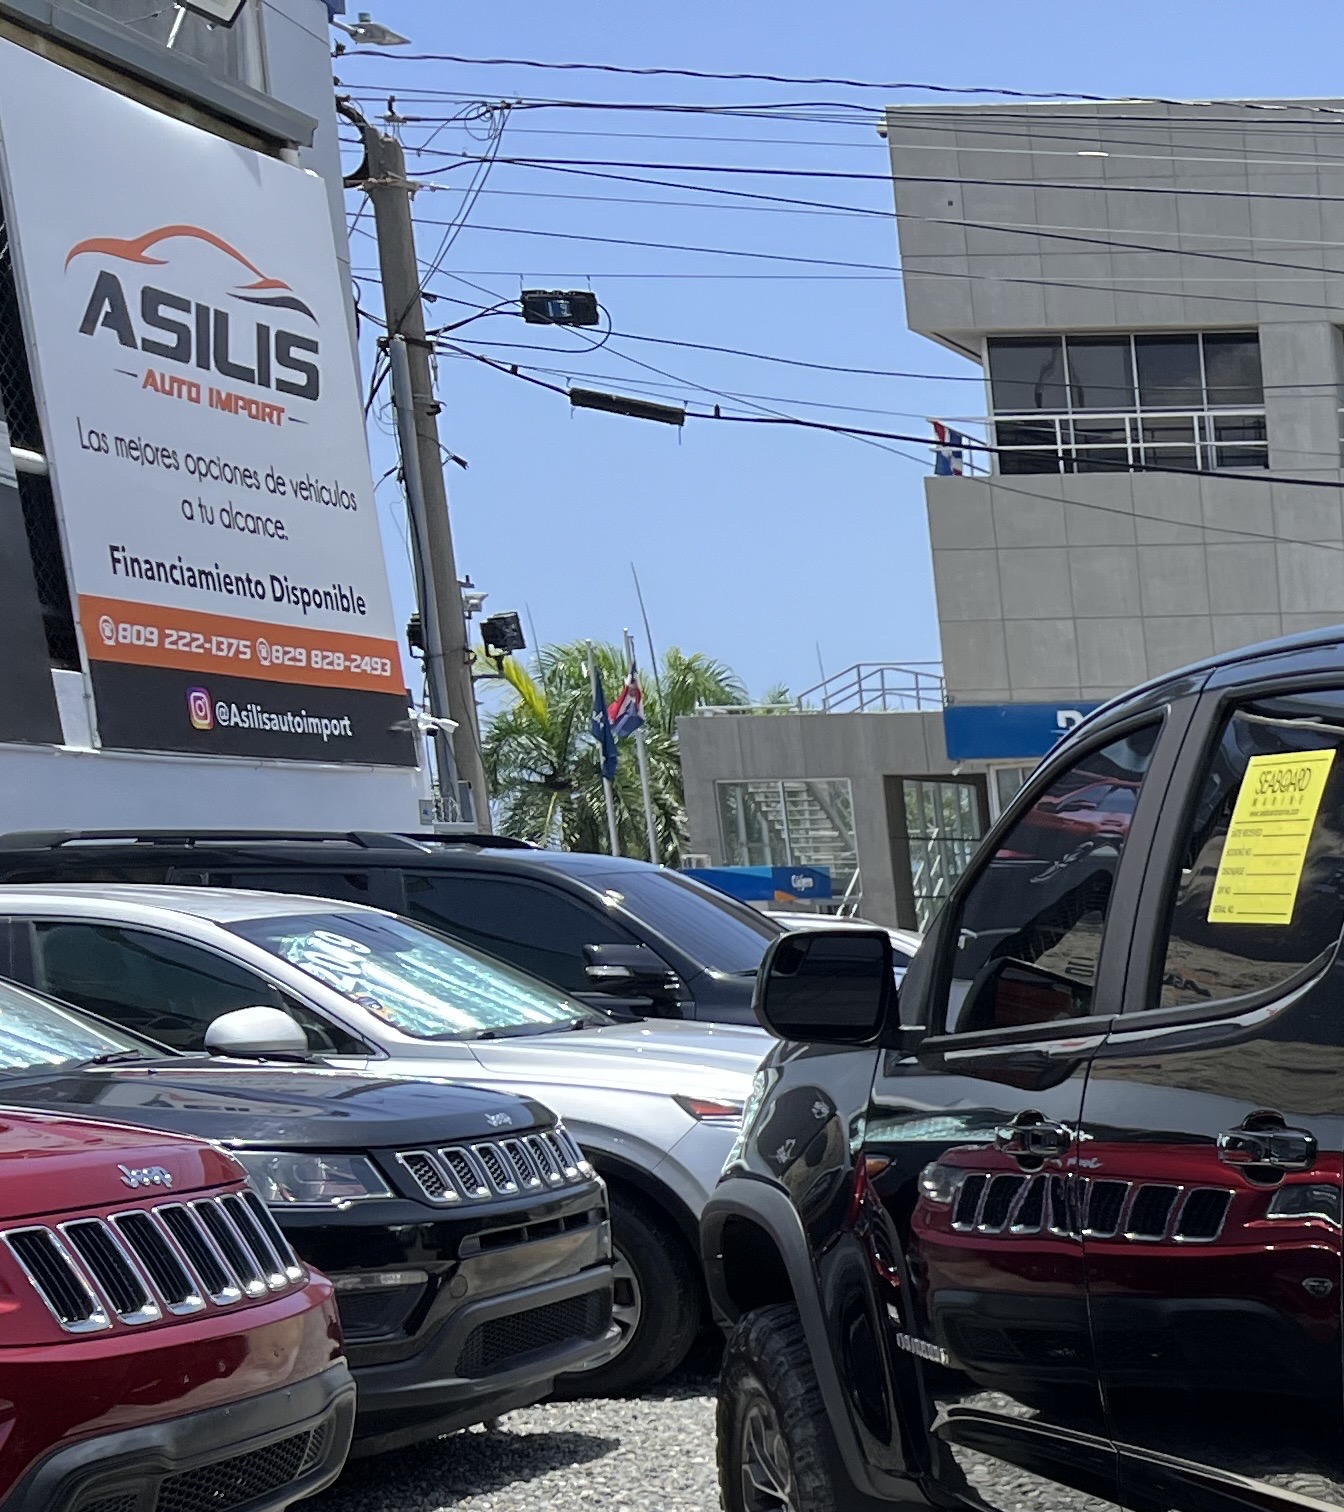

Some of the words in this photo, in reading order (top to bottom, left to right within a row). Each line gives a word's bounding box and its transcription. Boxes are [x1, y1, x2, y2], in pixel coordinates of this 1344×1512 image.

[78, 270, 319, 401] ASILIS
[142, 369, 201, 404] AUTO
[208, 387, 285, 426] IMPORT
[76, 416, 109, 454] Las
[114, 435, 179, 470] mejores
[184, 453, 260, 490] opciones
[265, 465, 286, 496] de
[181, 498, 195, 521] a
[198, 497, 215, 525] tu
[109, 544, 266, 600] Financiamiento
[269, 574, 366, 615] Disponible
[117, 622, 159, 647] 809
[164, 629, 251, 660] 222-1375
[271, 645, 307, 667] 829
[310, 652, 391, 676] 828-2493
[215, 701, 353, 742] @Asilisautoimport
[1254, 767, 1312, 795] SEABOARD
[300, 929, 371, 993] 2019
[117, 1164, 173, 1188] Jeep
